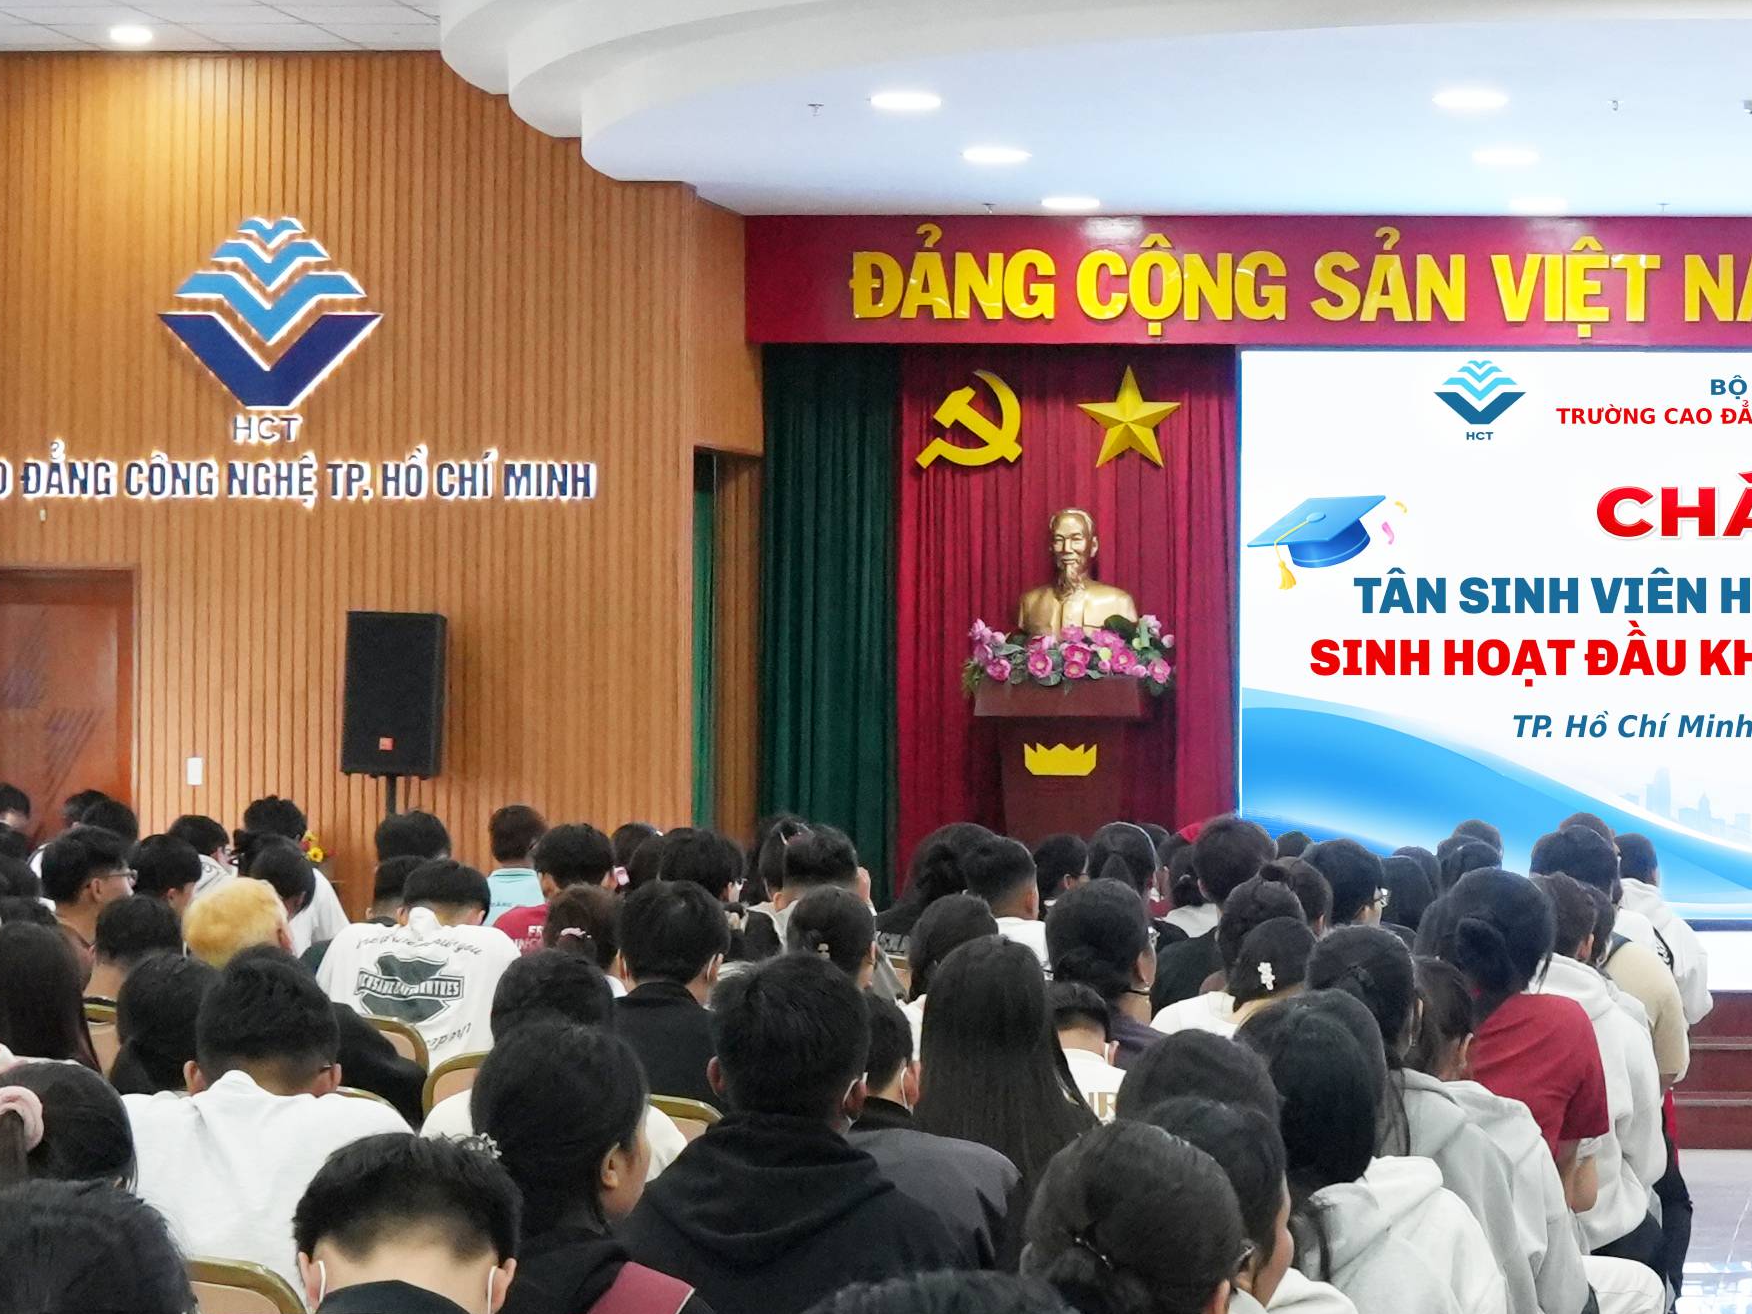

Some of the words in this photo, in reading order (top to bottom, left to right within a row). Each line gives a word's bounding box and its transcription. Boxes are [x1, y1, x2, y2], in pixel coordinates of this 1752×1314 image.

[848, 224, 1057, 321] ĐẢNG
[1076, 234, 1287, 336] CỘNG
[1312, 227, 1467, 322] SẢN
[1491, 237, 1663, 338] VIỆT
[1710, 374, 1748, 400] BỘ
[1555, 403, 1656, 425] TRƯỜNG
[1663, 407, 1713, 425] CAO
[233, 416, 300, 442] HCT
[1465, 431, 1494, 441] HCT
[20, 439, 116, 497] ĐẲNG
[125, 453, 218, 497] CÔNG
[227, 453, 315, 507] NGHỆ
[327, 462, 371, 498] TP.
[382, 445, 428, 498] HỒ
[436, 450, 495, 498] CHÍ
[503, 462, 594, 499] MINH
[1354, 567, 1447, 614] TÂN
[1459, 577, 1579, 614] SINH
[1590, 567, 1707, 614] VIÊN
[1310, 639, 1430, 676] SINH
[1444, 639, 1576, 687] HOẠT
[1584, 620, 1687, 676] ĐẦU
[1512, 714, 1552, 738] TP.
[1565, 710, 1609, 738] Hồ
[1617, 712, 1672, 738] Chí
